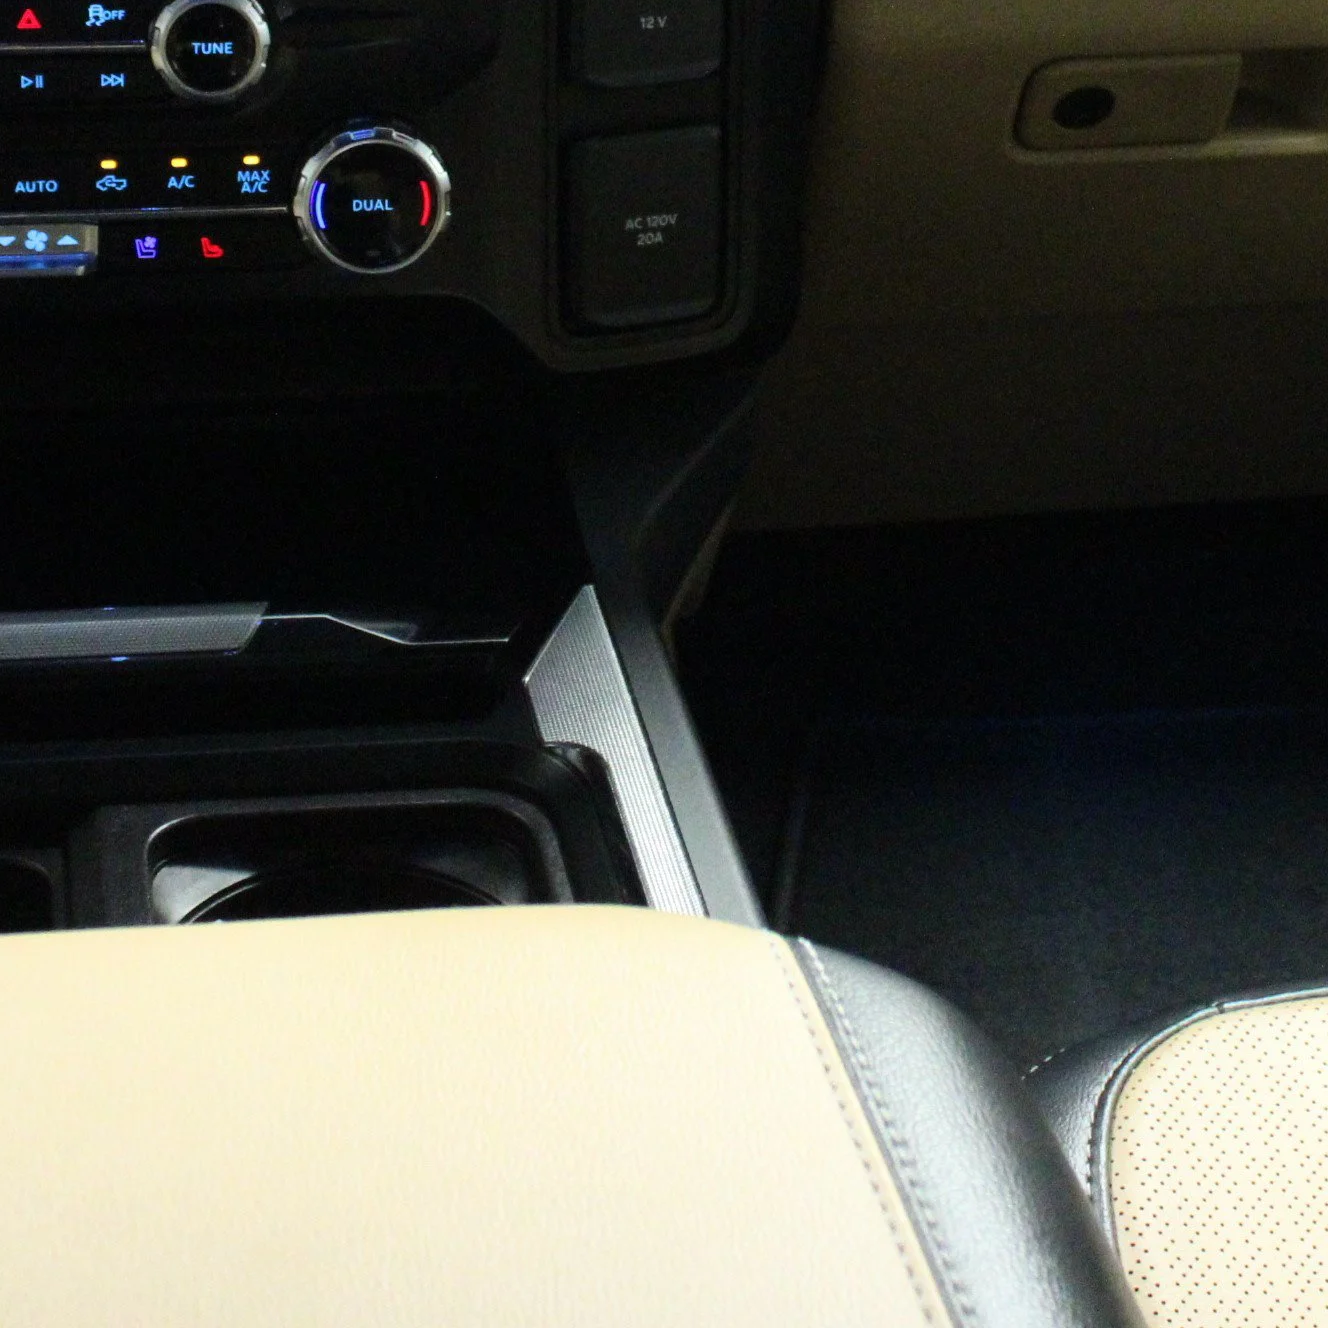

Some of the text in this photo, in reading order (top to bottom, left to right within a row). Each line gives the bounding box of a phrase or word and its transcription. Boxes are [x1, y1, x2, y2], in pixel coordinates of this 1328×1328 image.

[102, 9, 126, 21] OFF
[192, 41, 233, 55] TUNE
[167, 175, 195, 189] A/C
[237, 171, 270, 182] MAX
[15, 179, 59, 193] AUTO
[240, 181, 268, 193] A/C
[352, 199, 393, 212] DUAL
[625, 216, 643, 230] AC
